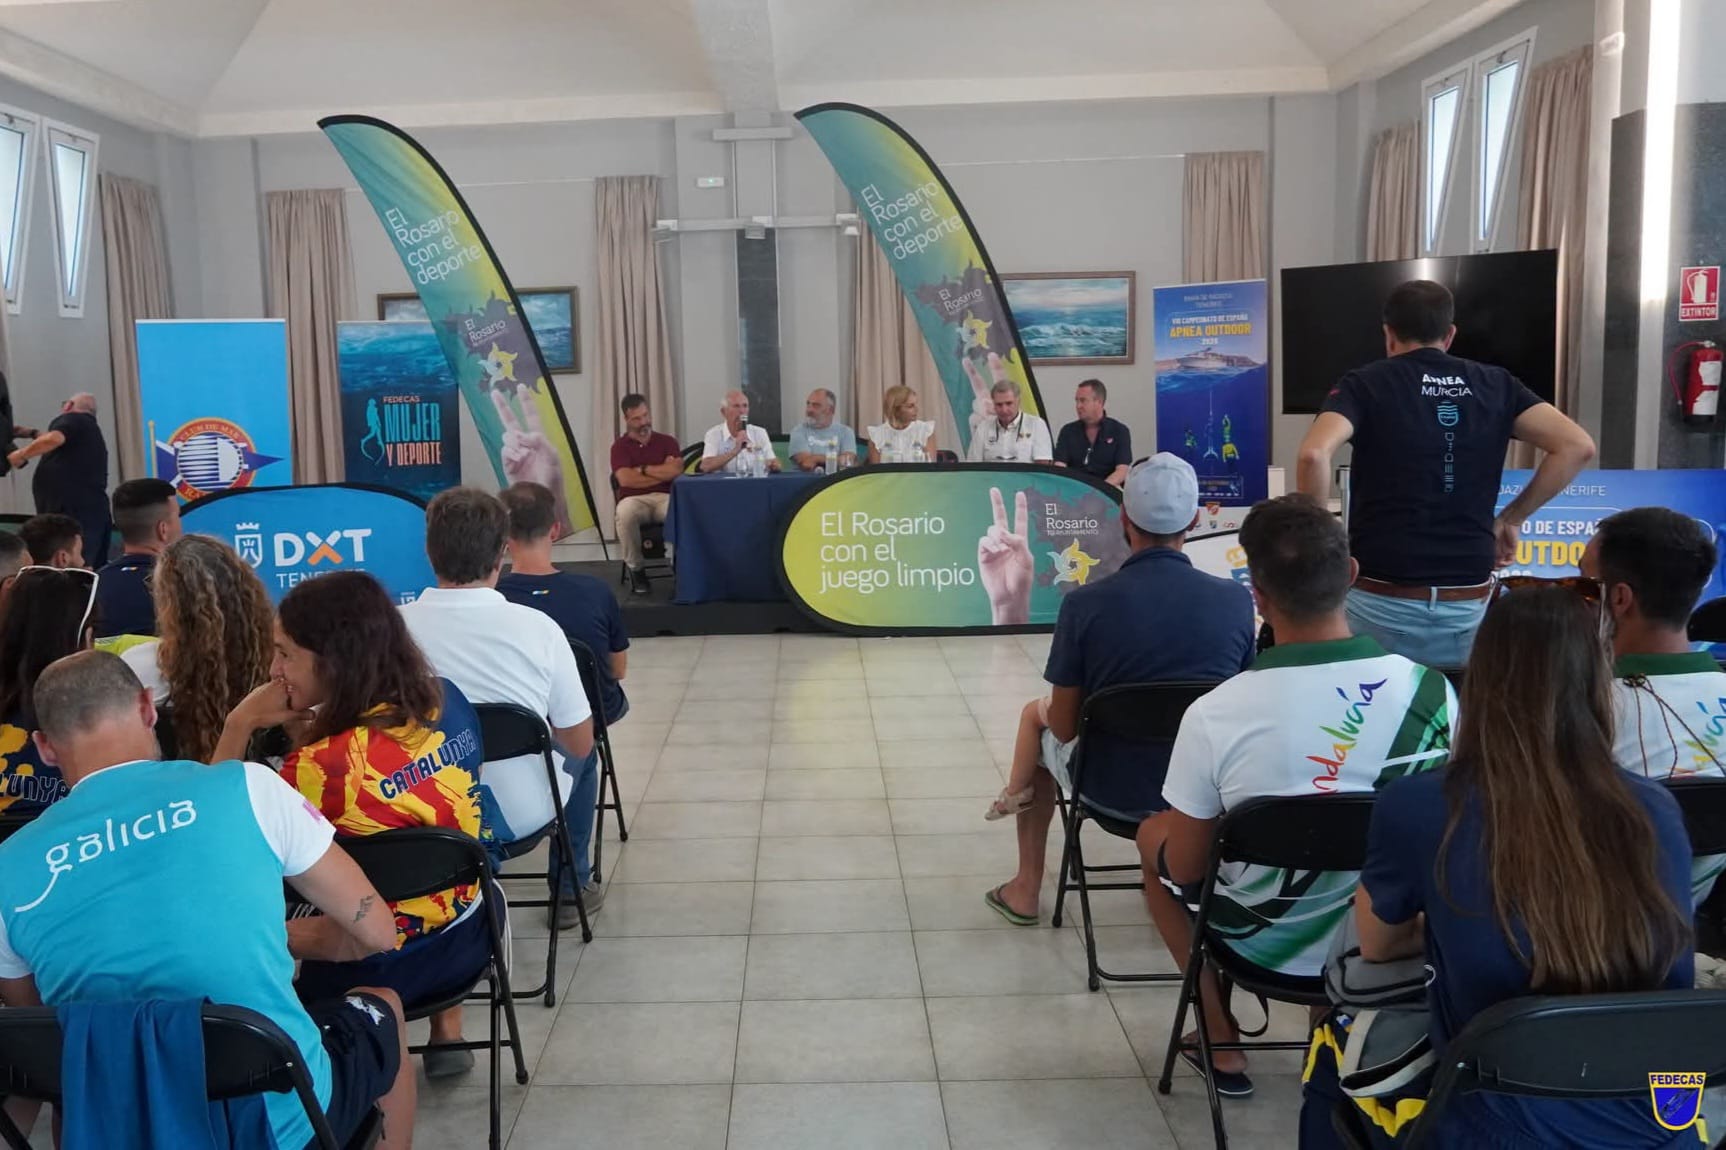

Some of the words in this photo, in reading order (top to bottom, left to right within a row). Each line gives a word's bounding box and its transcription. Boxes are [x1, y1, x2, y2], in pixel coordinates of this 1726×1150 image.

[861, 184, 884, 208] El
[871, 182, 939, 225] Rosario
[384, 207, 408, 230] El
[395, 210, 460, 248] Rosario
[884, 216, 918, 242] con
[920, 200, 938, 222] el
[407, 242, 441, 266] con
[442, 228, 460, 250] el
[893, 214, 962, 260] deporte
[416, 244, 482, 285] deporte
[938, 288, 951, 301] El
[943, 288, 982, 312] Rosario
[465, 318, 476, 331] El
[468, 319, 506, 342] Rosario
[1170, 325, 1202, 338] APNEA
[1205, 322, 1252, 336] OUTDOOR
[383, 395, 420, 403] FEDECAS
[1421, 385, 1473, 397] MURCIA
[384, 402, 441, 443] MUJER
[386, 443, 393, 467] Y
[397, 442, 442, 466] DEPORTE
[1563, 485, 1607, 496] NERIFE
[1045, 503, 1057, 516] El
[821, 512, 844, 537] El
[852, 511, 945, 536] Rosario
[1046, 516, 1098, 530] Rosario
[1535, 521, 1554, 535] DE
[1557, 518, 1601, 535] ESPA
[274, 528, 372, 566] DXT
[820, 544, 867, 563] con
[874, 535, 897, 562] el
[1515, 540, 1587, 567] UTDO
[819, 566, 889, 594] juego
[897, 562, 975, 591] limpio
[1306, 678, 1388, 796] ndalucía
[379, 728, 477, 800] CATALUNYA
[14, 799, 198, 913] galicia
